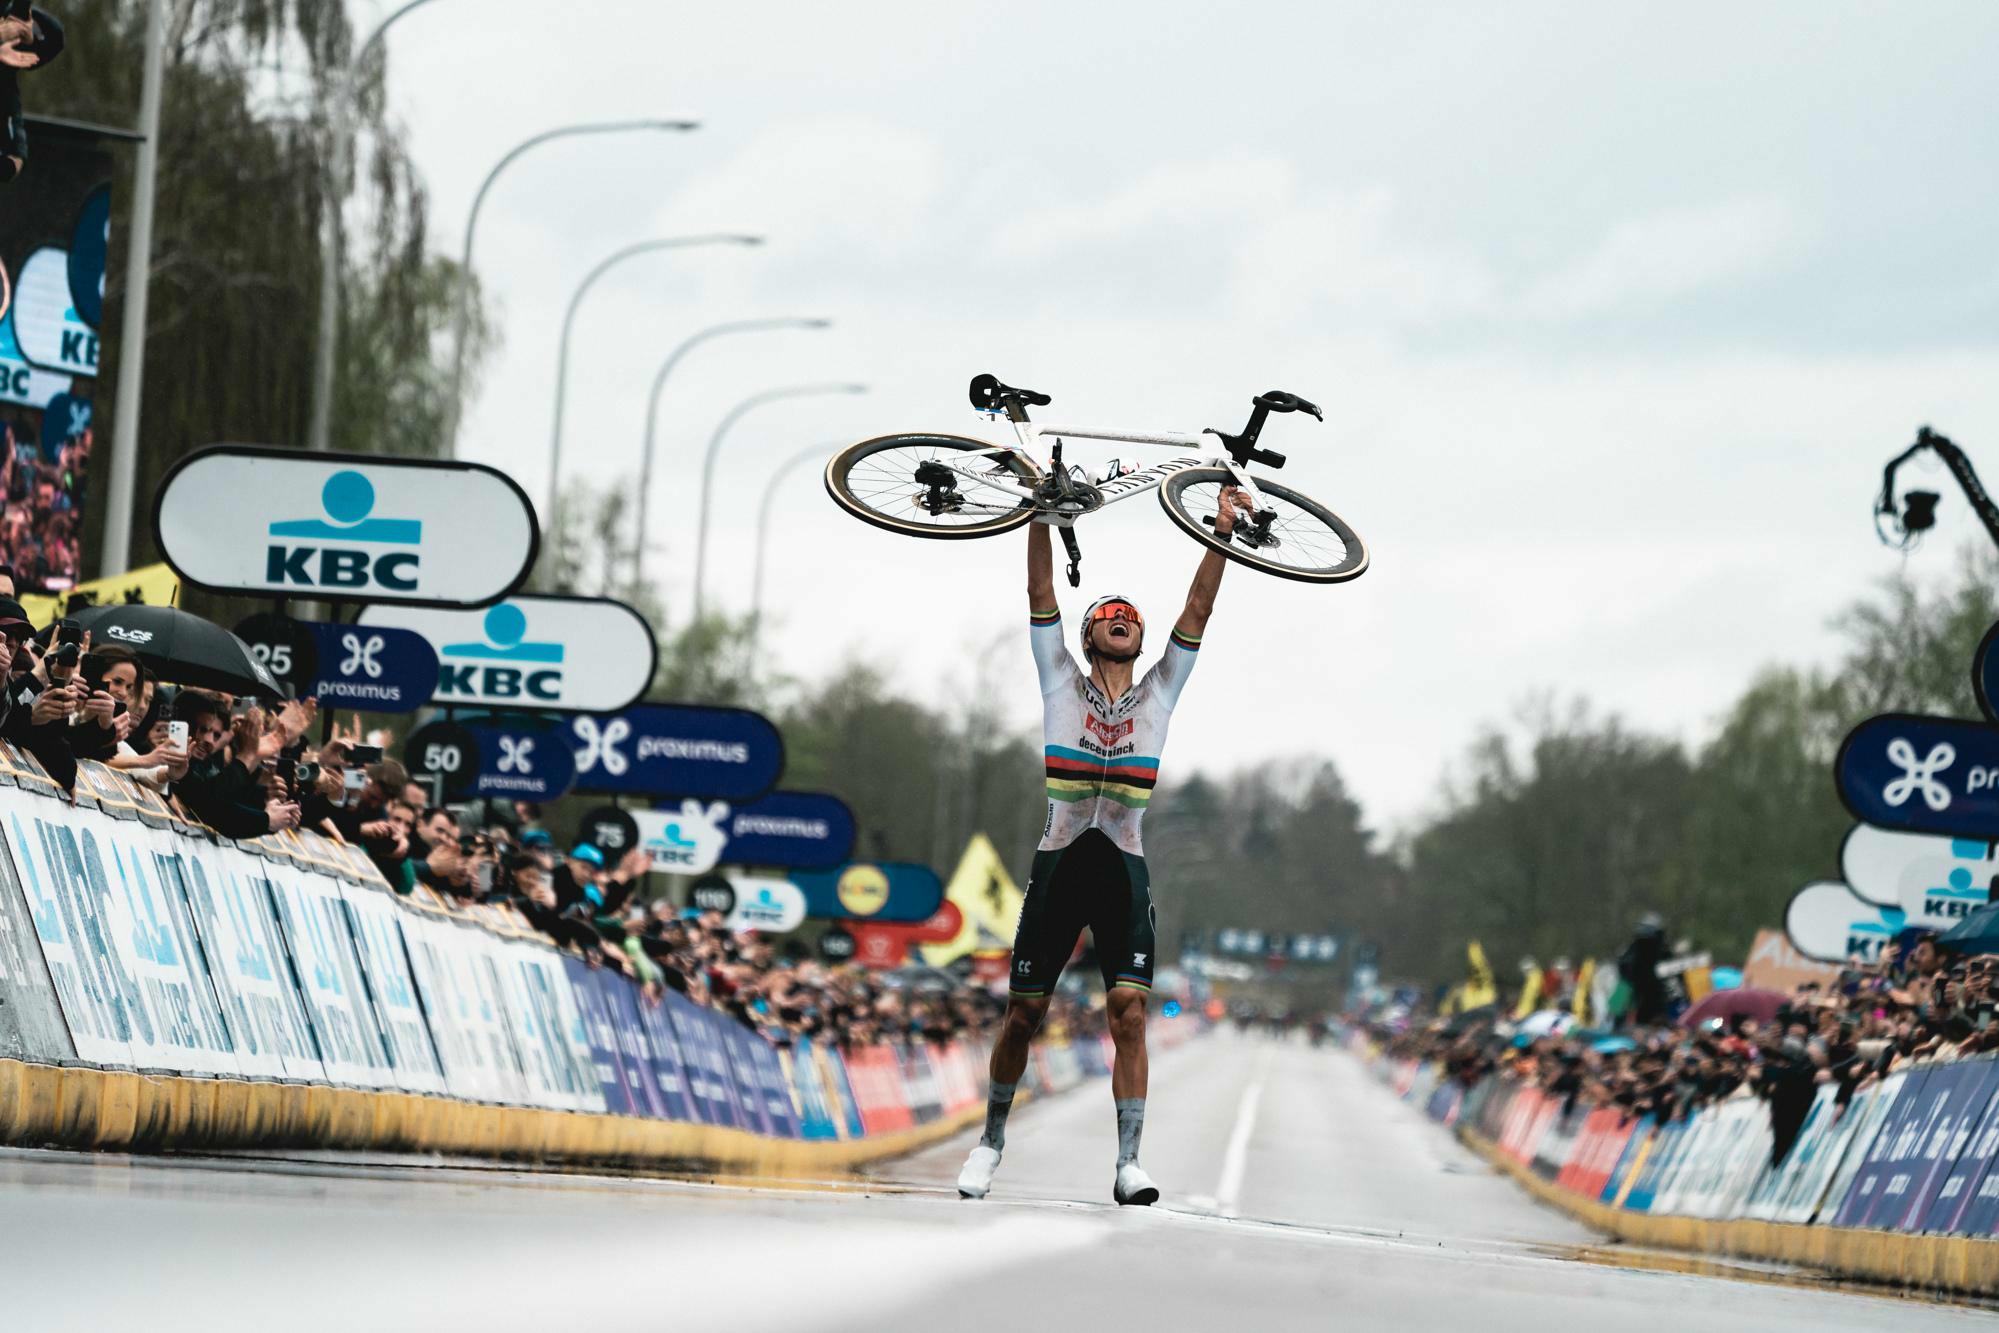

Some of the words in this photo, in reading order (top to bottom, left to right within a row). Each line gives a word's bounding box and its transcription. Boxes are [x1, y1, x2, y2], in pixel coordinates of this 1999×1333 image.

[1098, 457, 1202, 495] CANYON
[266, 546, 420, 592] KBC
[317, 680, 401, 703] proximus
[438, 663, 562, 702] KBC
[1085, 690, 1106, 719] UCI
[424, 745, 461, 772] 50
[638, 735, 749, 764] proximus
[478, 774, 546, 793] proximus
[1966, 767, 1999, 795] pr
[594, 822, 625, 848] 75
[733, 814, 829, 840] proximus
